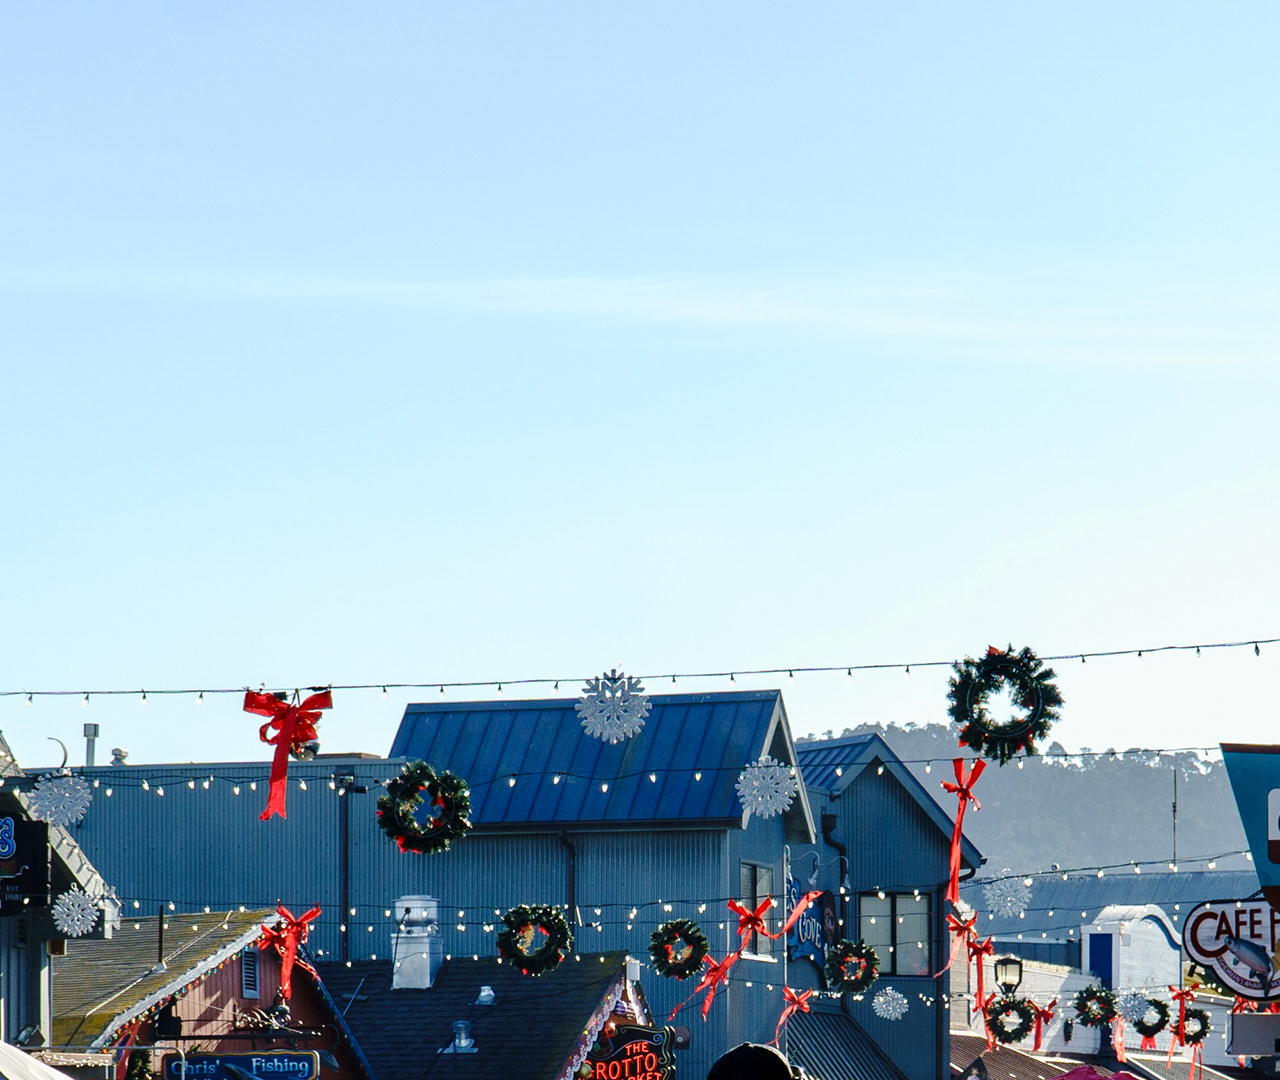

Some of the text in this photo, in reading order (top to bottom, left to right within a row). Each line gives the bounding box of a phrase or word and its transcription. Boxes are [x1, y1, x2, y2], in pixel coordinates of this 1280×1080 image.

[1190, 908, 1263, 958] CAFE
[625, 1041, 649, 1056] THE
[172, 1058, 309, 1078] Chris' Fishing
